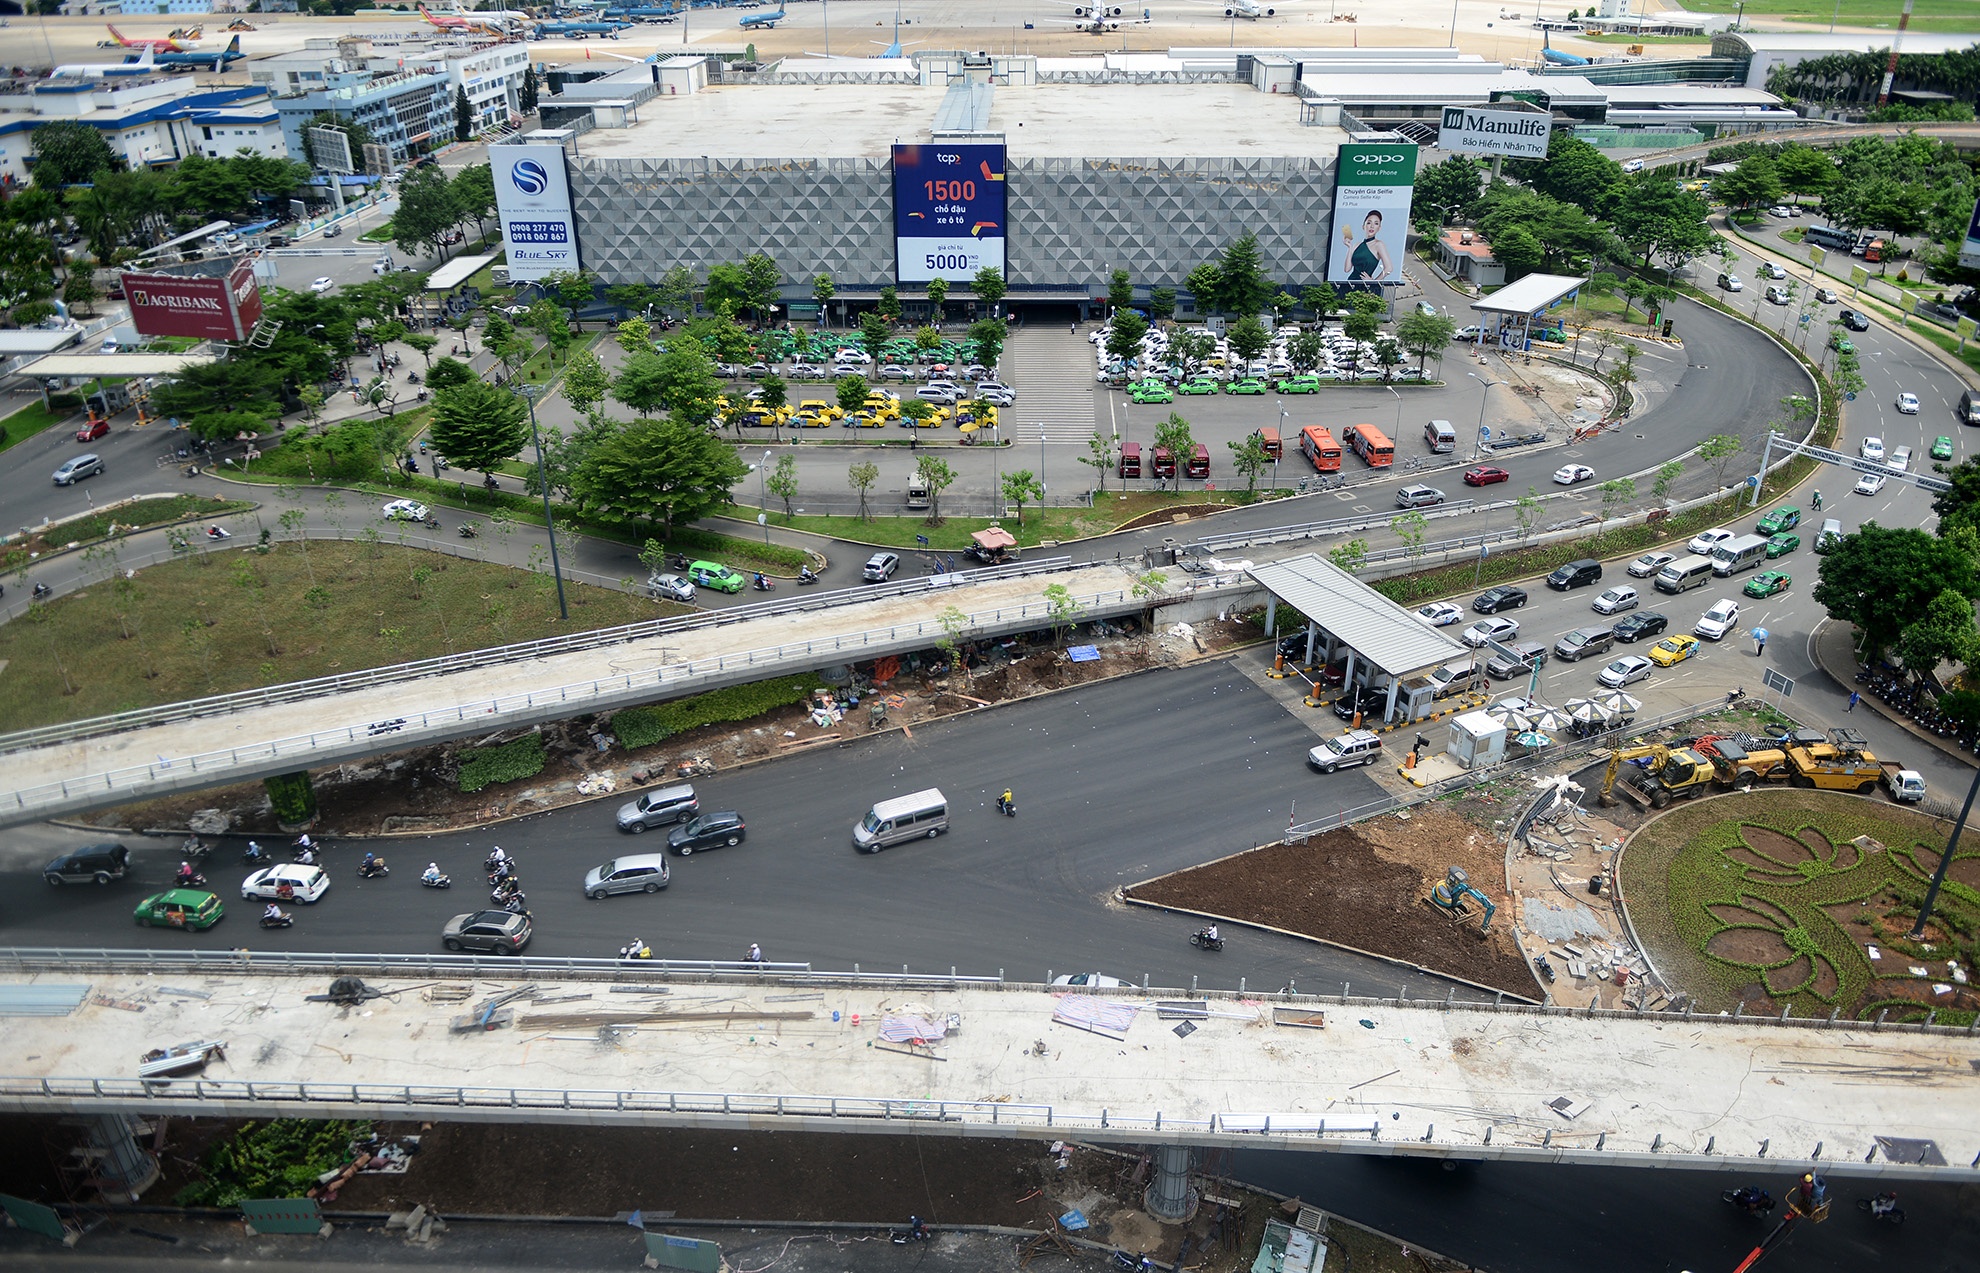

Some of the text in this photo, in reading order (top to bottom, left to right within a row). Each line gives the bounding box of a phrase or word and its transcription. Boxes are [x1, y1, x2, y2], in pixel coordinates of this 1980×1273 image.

[1465, 114, 1545, 136] Manulife
[1503, 142, 1525, 151] Nhân
[1527, 143, 1542, 153] Thọ
[924, 180, 976, 201] 1500
[934, 203, 966, 215] chỗ đậu
[948, 215, 954, 224] ô
[955, 215, 965, 224] tô
[510, 224, 565, 232] 0908 277 470
[512, 233, 566, 241] 0918 067 867
[926, 254, 968, 270] 5000
[150, 295, 222, 310] AGRIBANK
